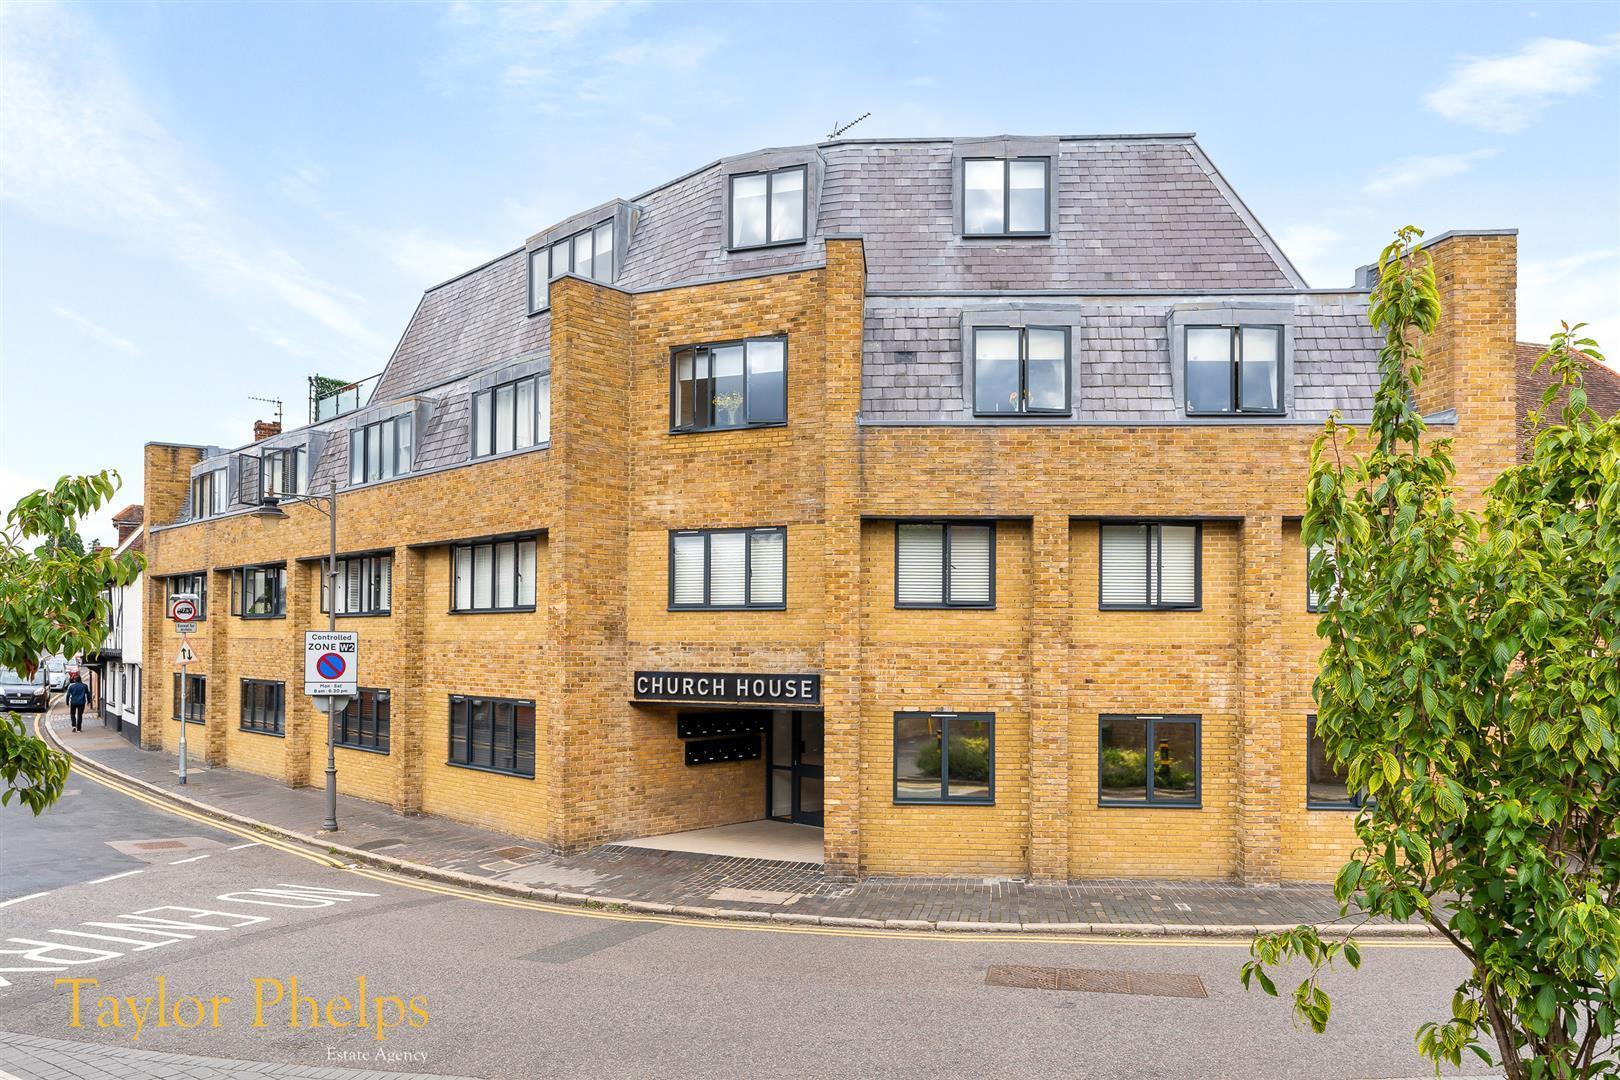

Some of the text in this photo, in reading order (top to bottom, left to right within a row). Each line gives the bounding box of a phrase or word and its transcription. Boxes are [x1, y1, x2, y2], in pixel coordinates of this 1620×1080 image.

[308, 643, 355, 652] ZONE W2
[637, 676, 812, 698] CHURCH HOUSE
[216, 884, 381, 908] NO
